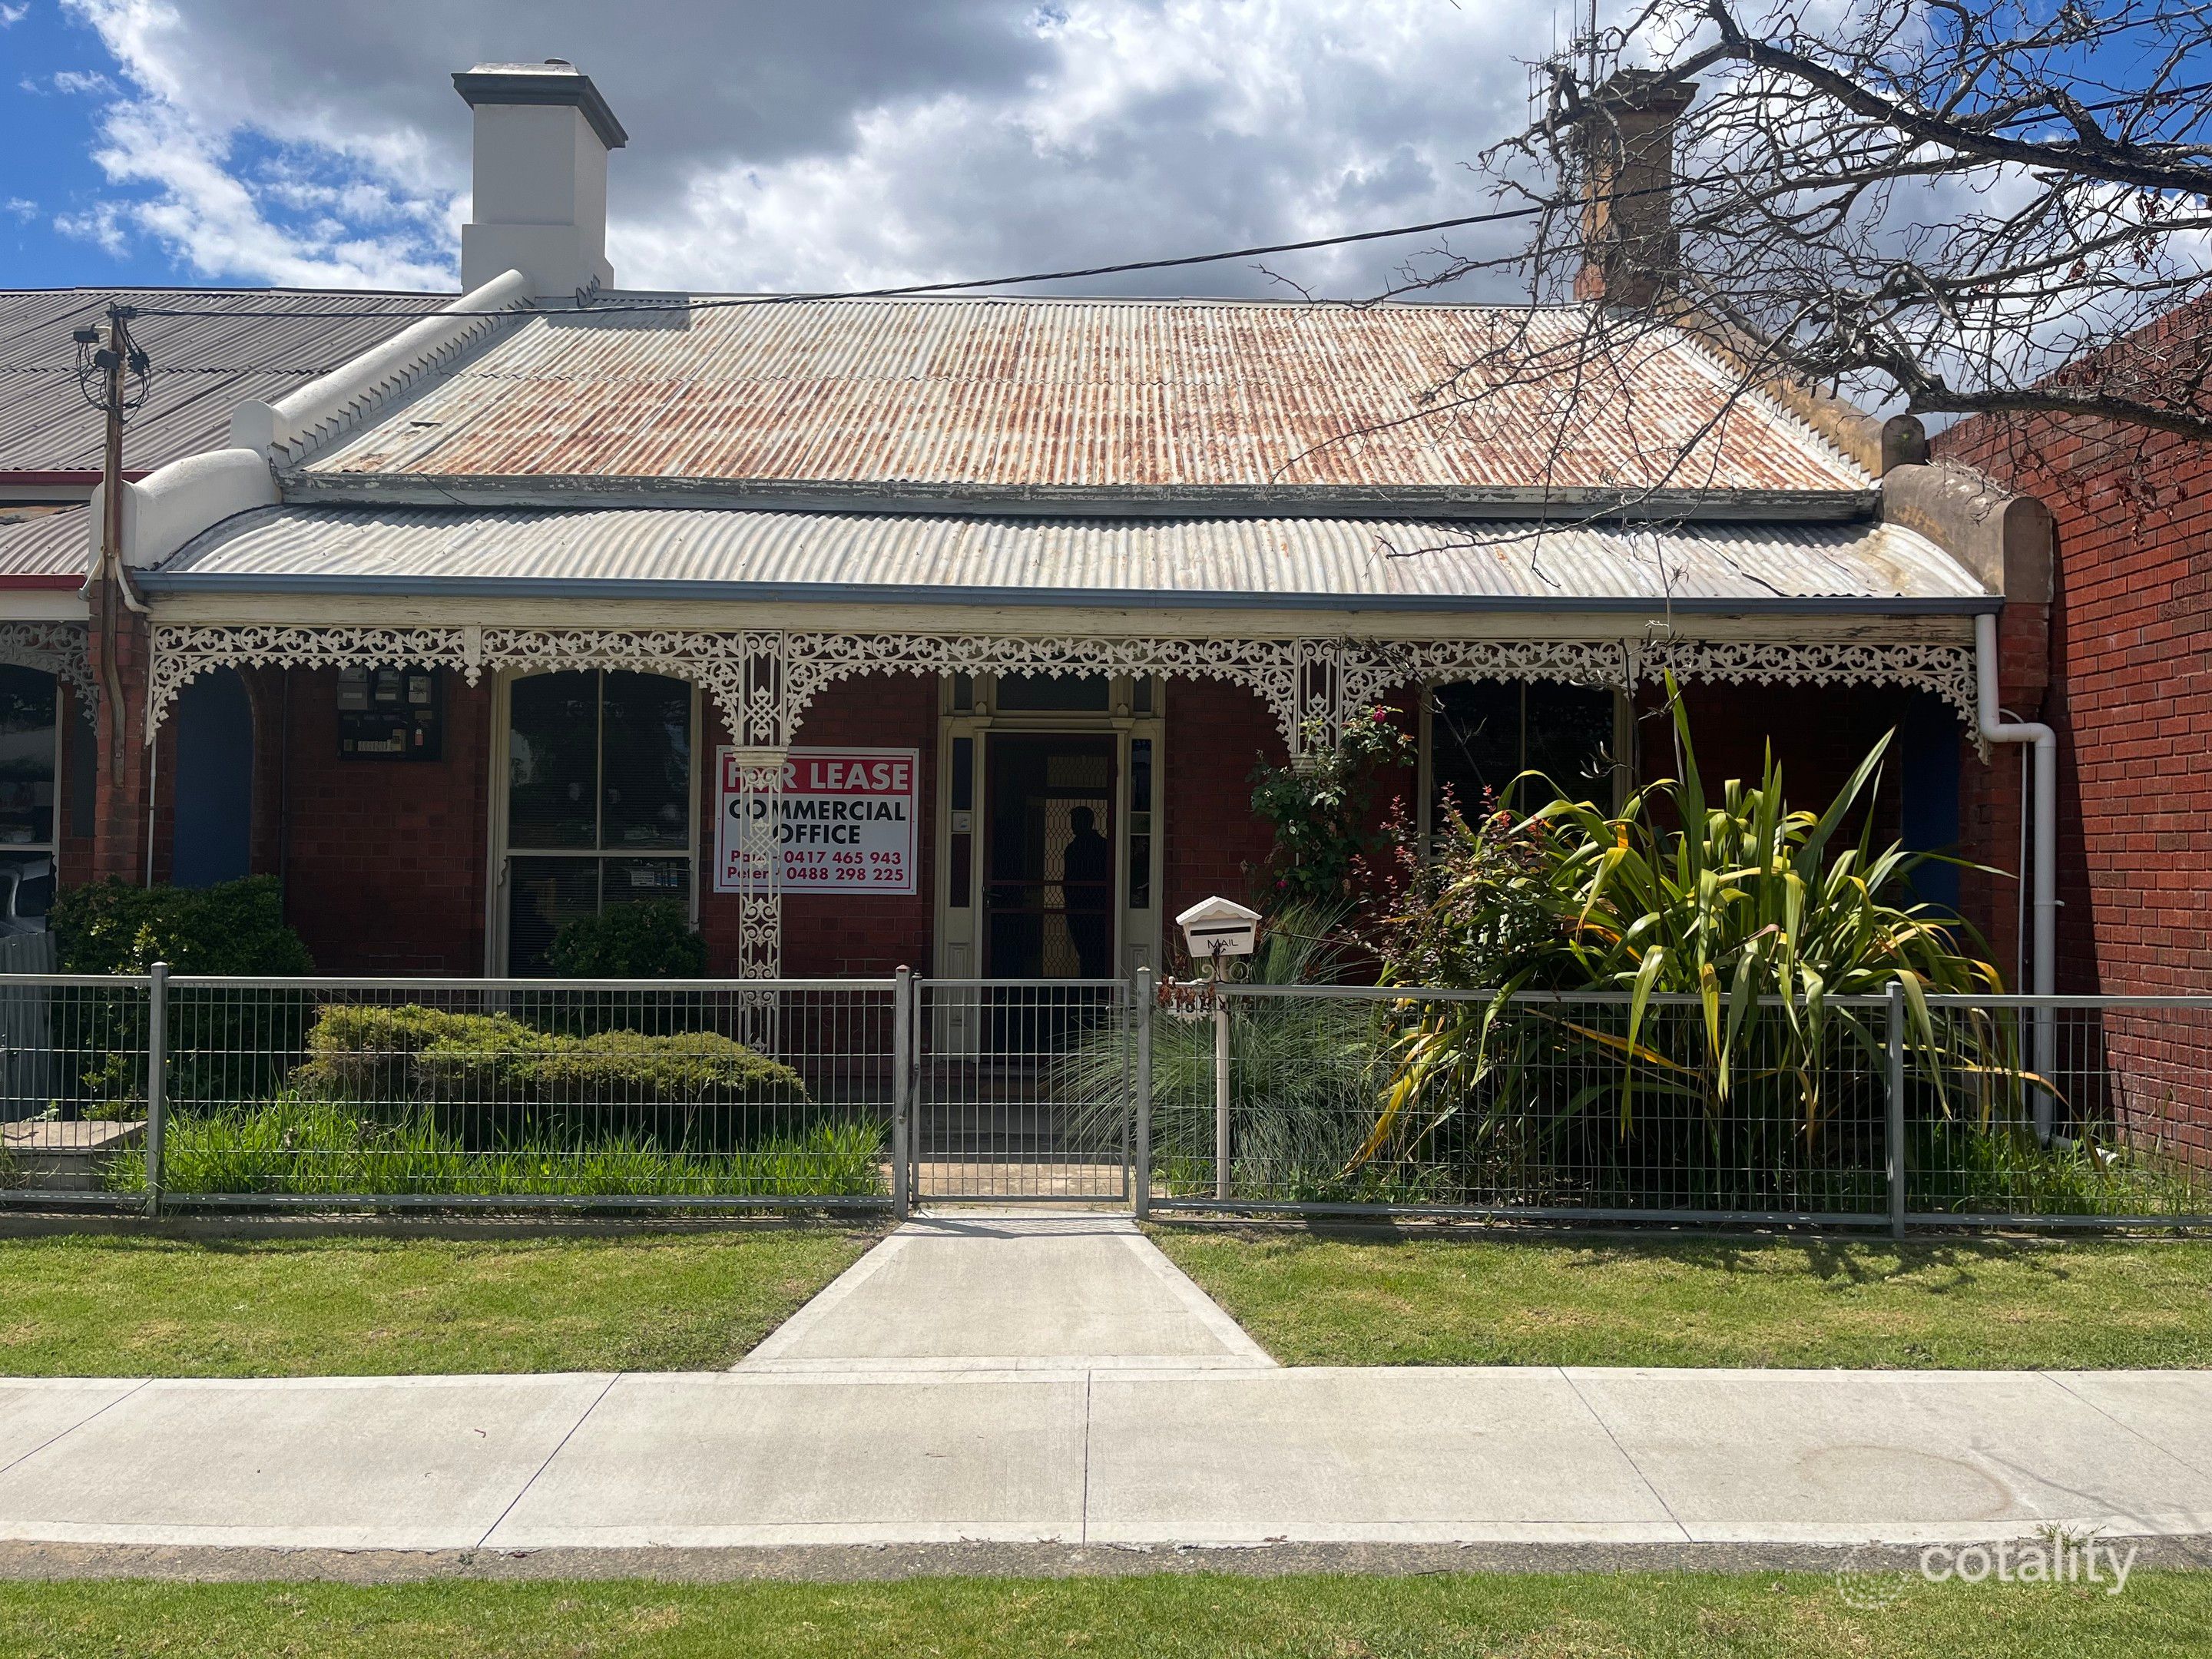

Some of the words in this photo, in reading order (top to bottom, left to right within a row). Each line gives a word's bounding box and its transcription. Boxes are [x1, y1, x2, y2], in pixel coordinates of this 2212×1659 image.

[727, 761, 798, 789] FR
[810, 762, 909, 790] LEASE
[729, 799, 906, 821] COMMERCIAL
[773, 823, 860, 844] OFFICE
[783, 850, 827, 863] 0417
[832, 851, 863, 864] 465
[869, 851, 902, 865] 943
[786, 866, 829, 880] 0488
[835, 867, 866, 880] 298
[873, 868, 904, 881] 225
[1207, 939, 1239, 949] MAIL
